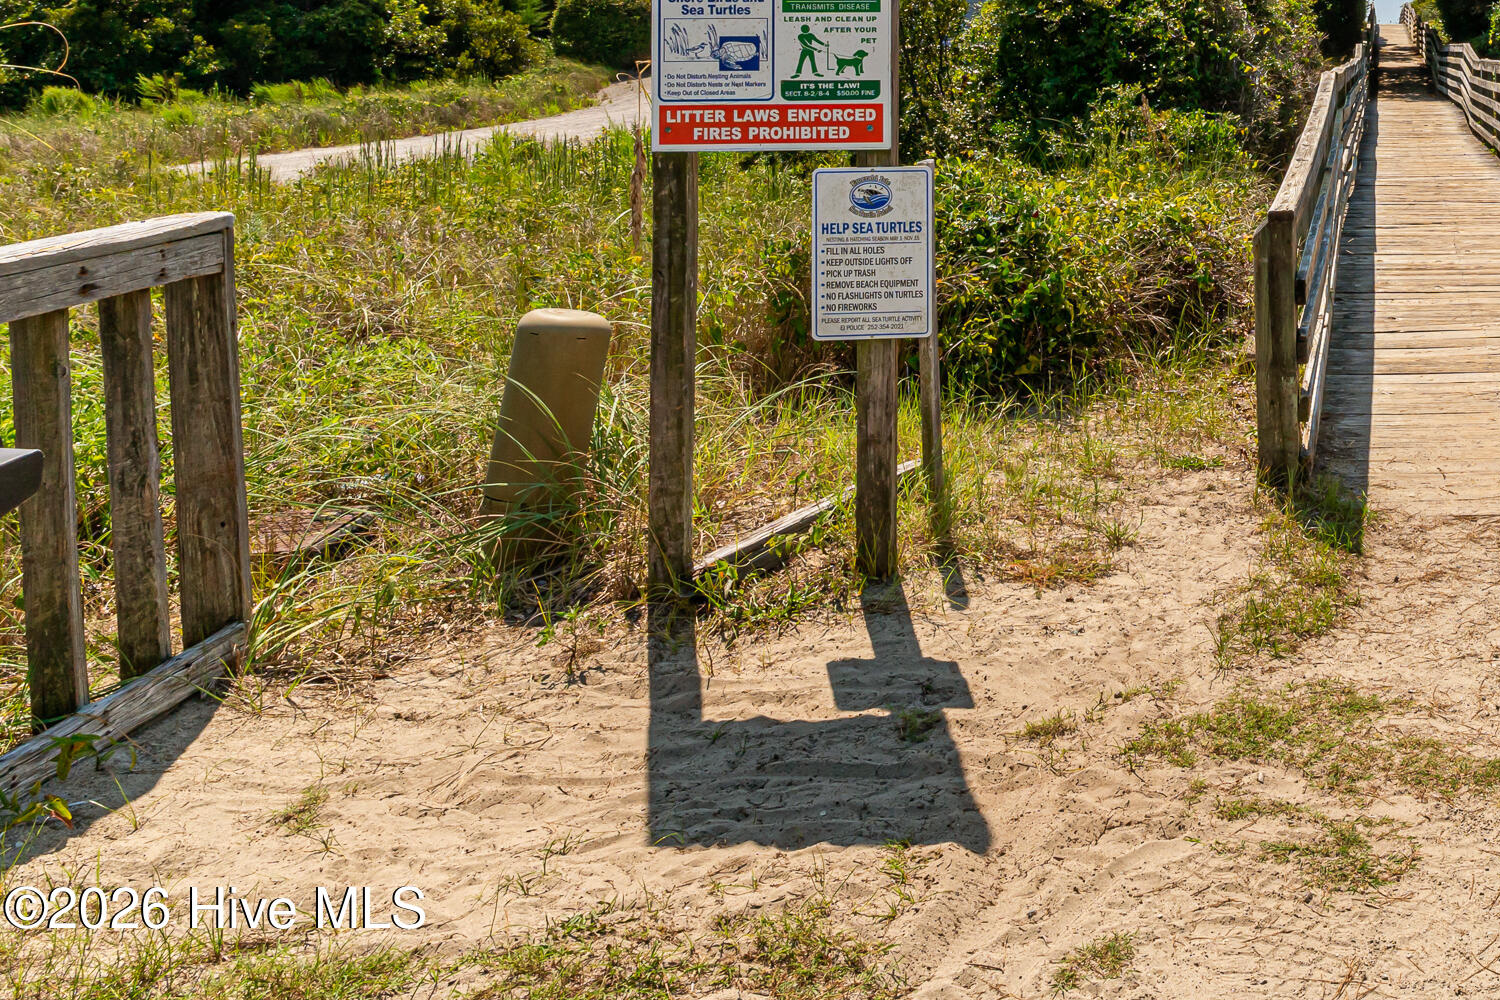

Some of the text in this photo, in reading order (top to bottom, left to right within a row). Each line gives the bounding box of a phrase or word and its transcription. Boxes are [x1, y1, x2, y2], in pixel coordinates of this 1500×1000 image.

[681, 4, 751, 15] Sea Turtles
[666, 108, 877, 123] LITTER LAWS ENFORCED
[693, 126, 850, 140] FIRES PROHIBITED
[821, 221, 922, 234] HELP SEA TURTLES
[826, 247, 840, 255] FILL
[863, 246, 885, 254] HOLES
[826, 258, 843, 266] KEEP
[845, 258, 874, 266] OUTSIDE
[875, 257, 899, 265] LIGHTS
[854, 269, 876, 277] TRASH
[826, 279, 919, 289] REMOVE BEACH EQUIPMENT
[826, 290, 924, 300] NO FLASHLIGHTS ON TURTLES
[837, 303, 877, 311] FIREWORKS
